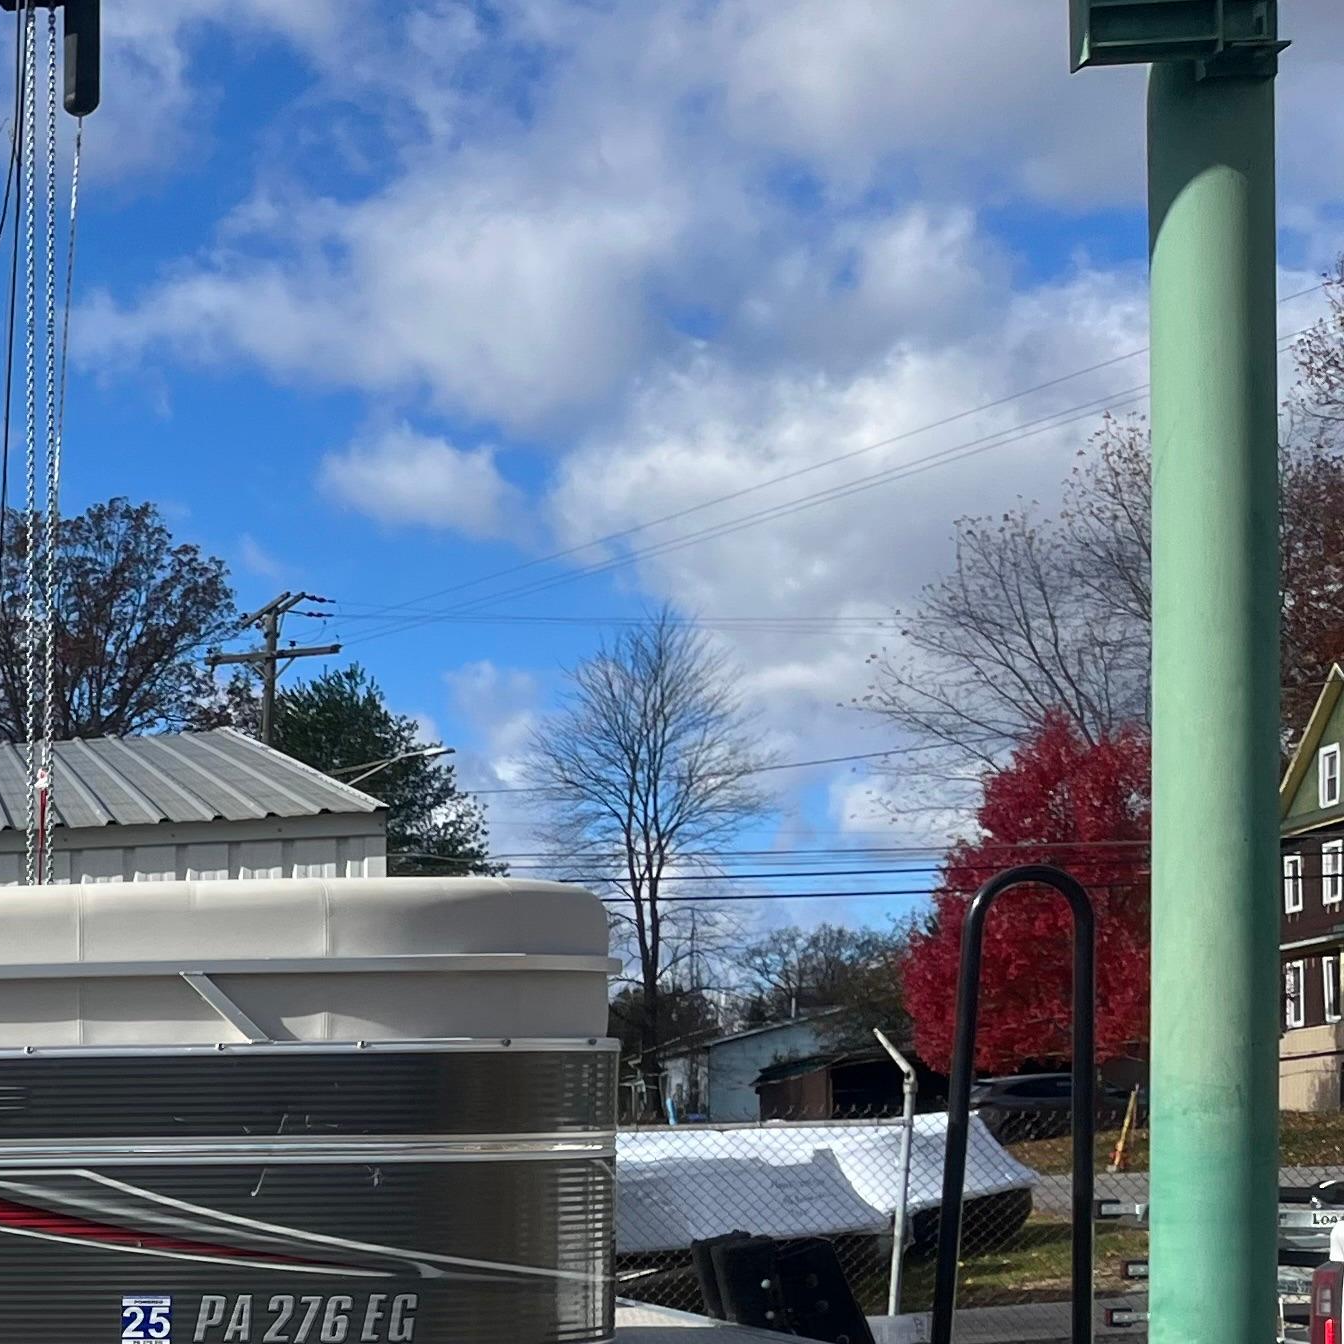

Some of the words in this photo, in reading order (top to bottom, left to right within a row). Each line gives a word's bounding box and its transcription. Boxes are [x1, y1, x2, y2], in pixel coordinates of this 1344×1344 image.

[122, 1306, 171, 1338] 25
[192, 1294, 253, 1344] PA
[262, 1294, 354, 1344] 276
[360, 1293, 419, 1344] EG
